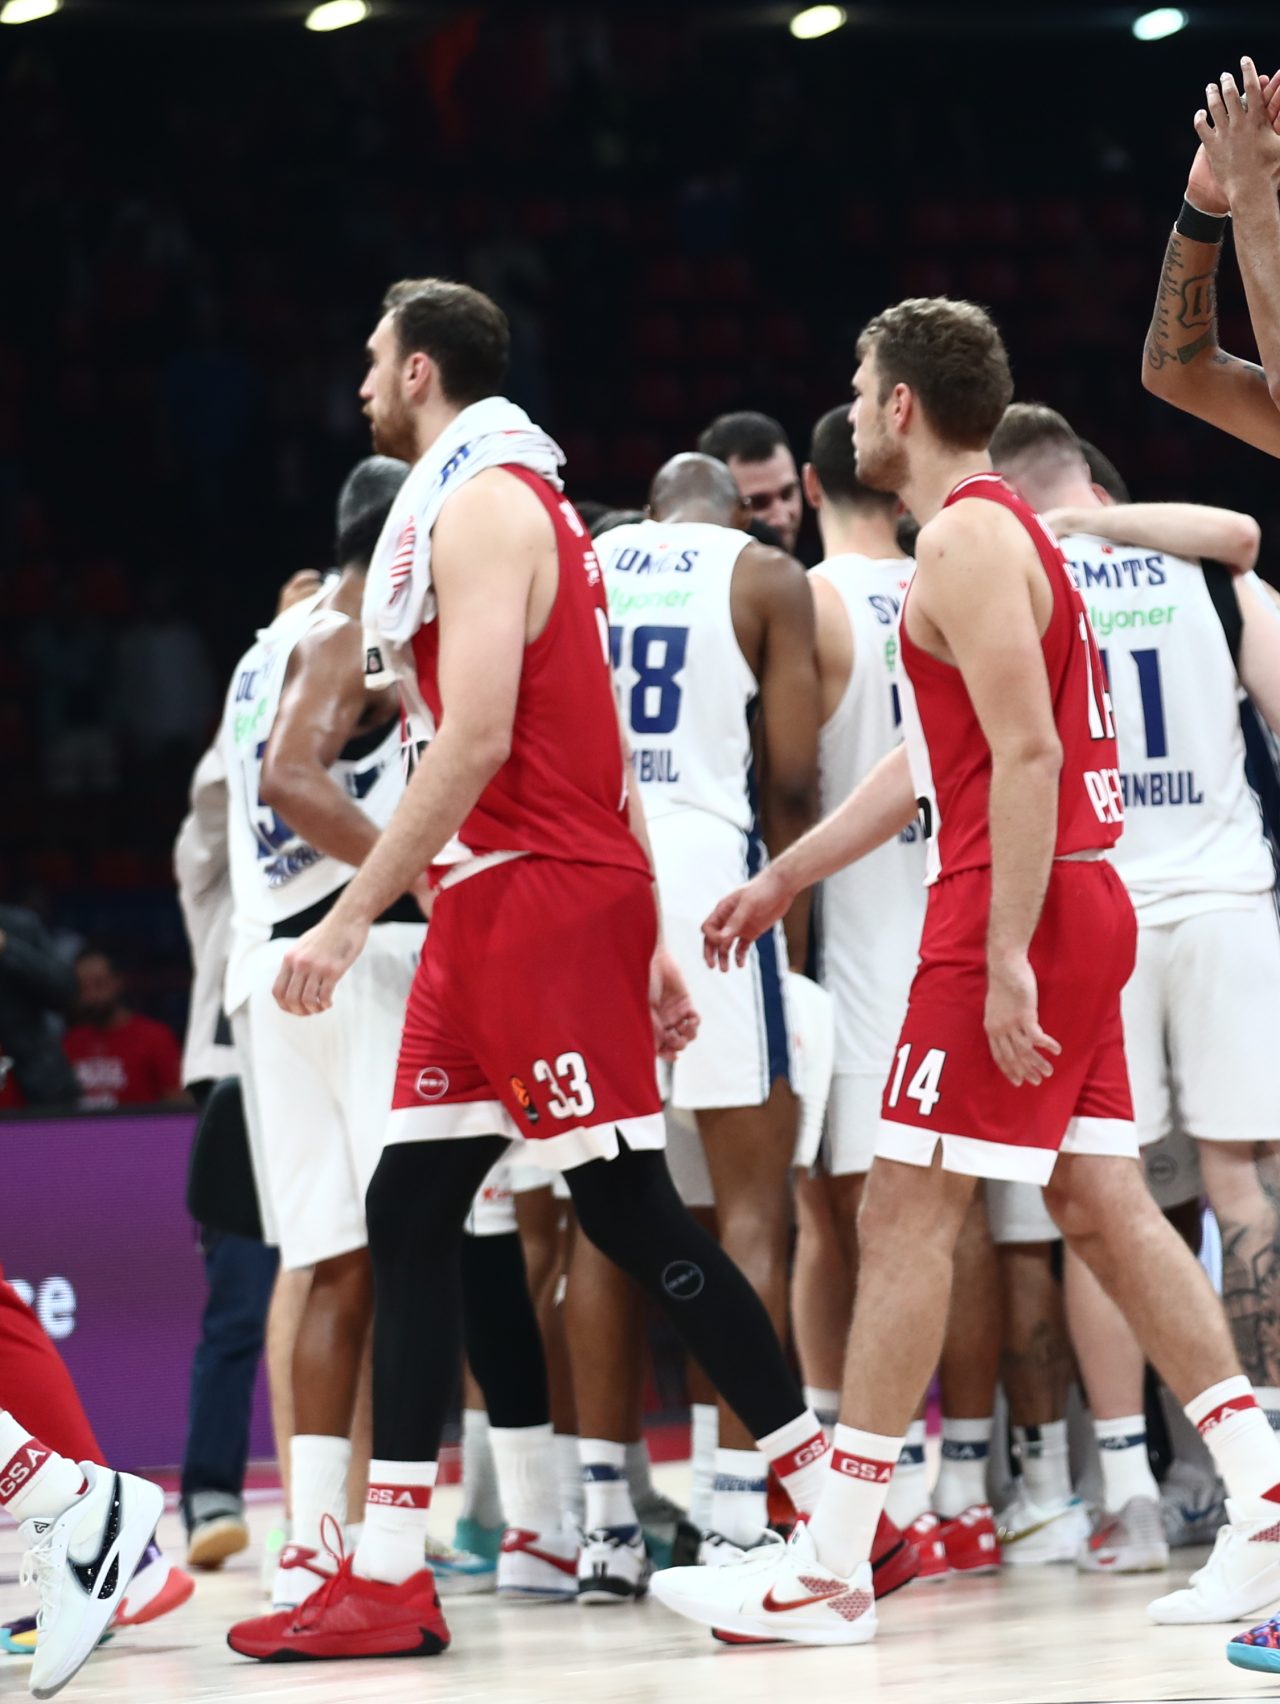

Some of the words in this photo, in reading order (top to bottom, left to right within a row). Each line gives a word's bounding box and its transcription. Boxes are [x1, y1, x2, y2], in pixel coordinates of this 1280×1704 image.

[532, 1051, 596, 1120] 33
[887, 1042, 948, 1117] 14
[0, 1448, 48, 1498] GSA
[839, 1456, 893, 1484] GSA
[367, 1487, 416, 1508] GSA
